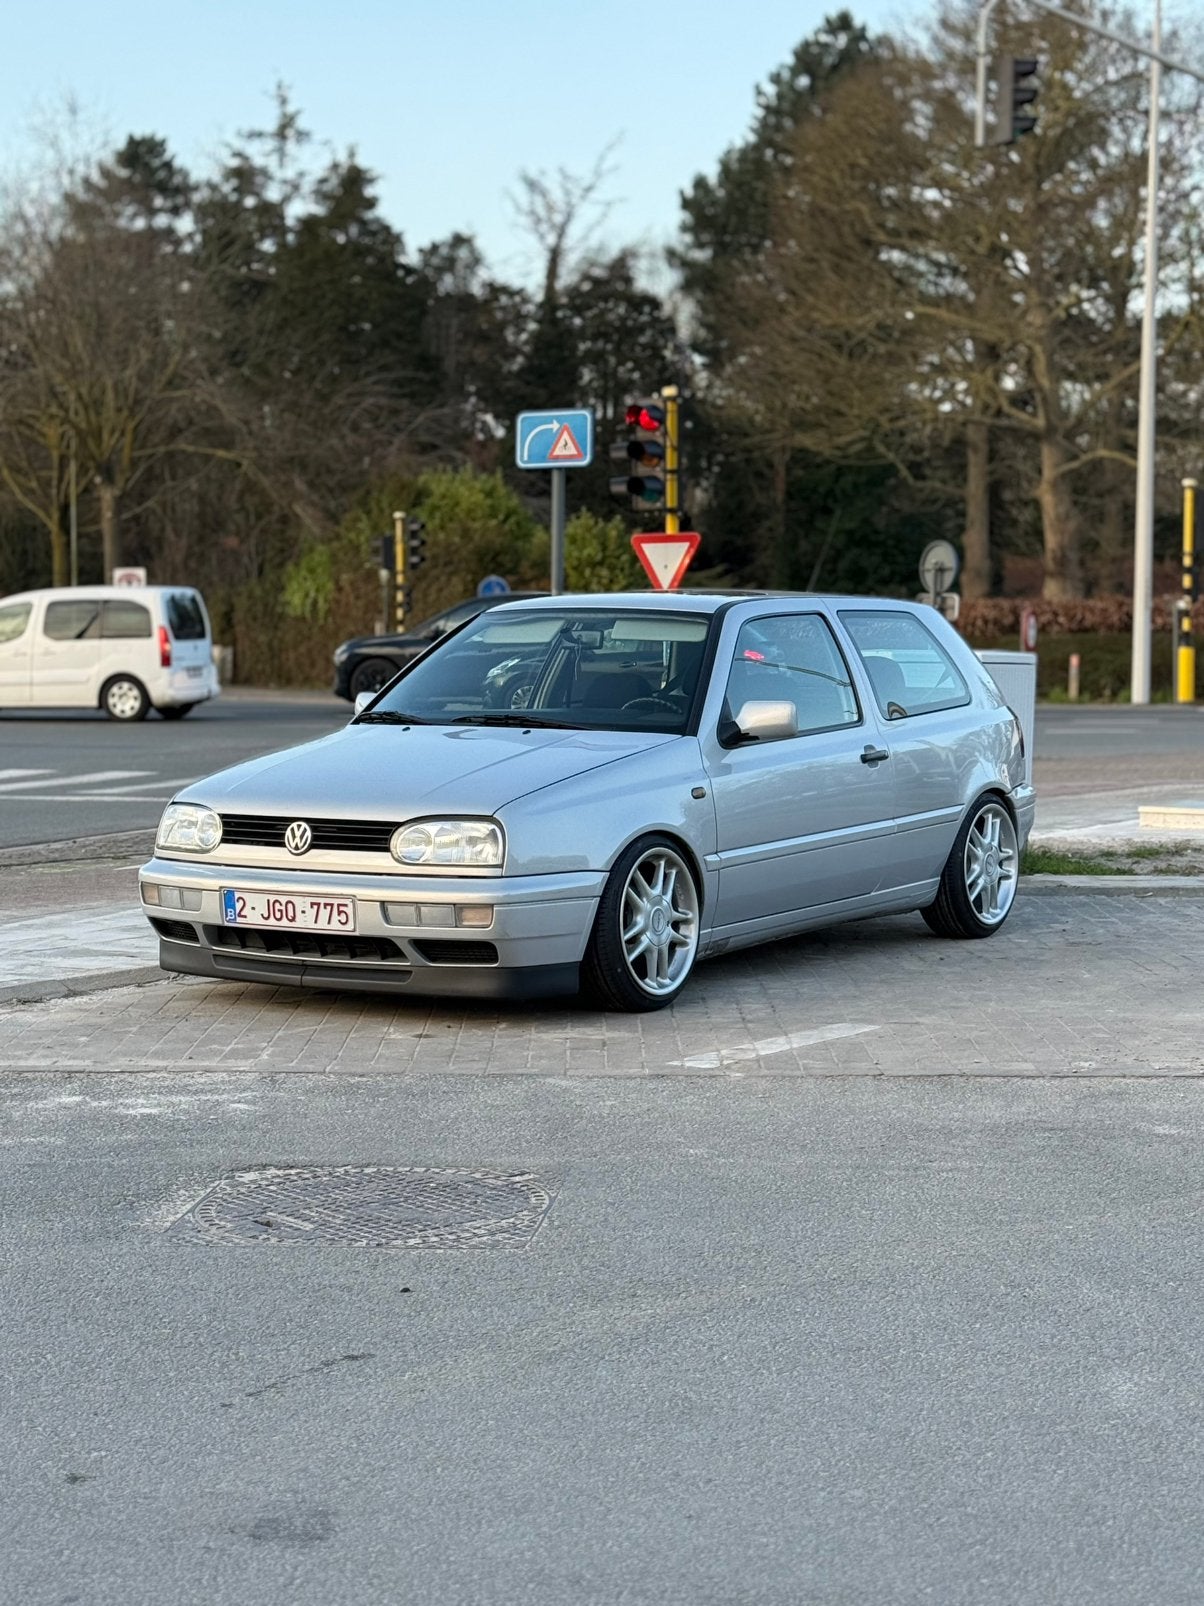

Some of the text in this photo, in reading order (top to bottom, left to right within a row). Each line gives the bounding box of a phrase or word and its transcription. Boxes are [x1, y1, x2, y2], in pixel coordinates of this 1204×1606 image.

[285, 821, 311, 853] VW
[227, 908, 235, 920] B
[236, 896, 349, 925] 2-JGQ-775
